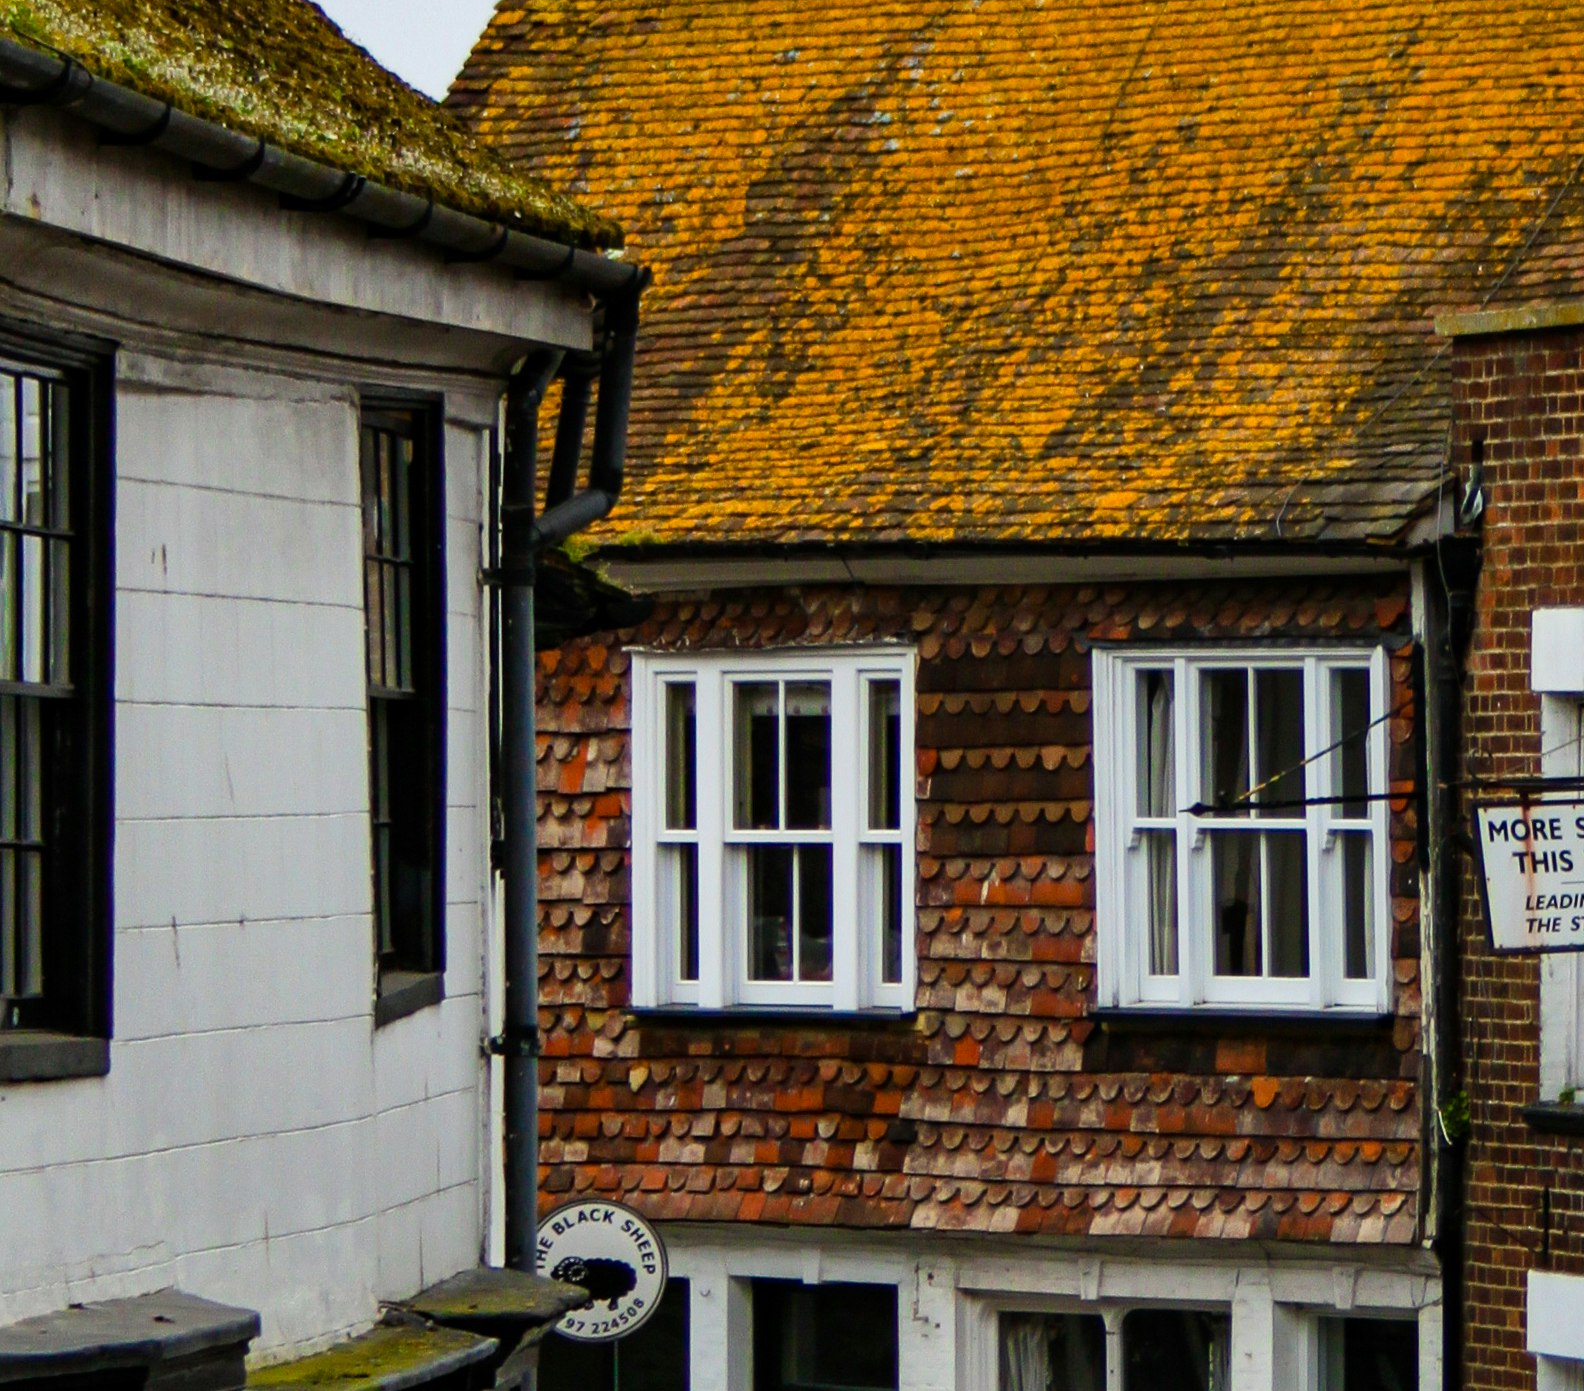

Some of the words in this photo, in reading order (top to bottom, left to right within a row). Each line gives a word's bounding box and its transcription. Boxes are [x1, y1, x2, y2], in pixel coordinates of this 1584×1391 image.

[1487, 818, 1563, 842] MORE
[1512, 849, 1574, 874] THIS
[1525, 917, 1562, 934] THE
[551, 1208, 616, 1236] BLACK
[620, 1219, 656, 1275] SHEEP
